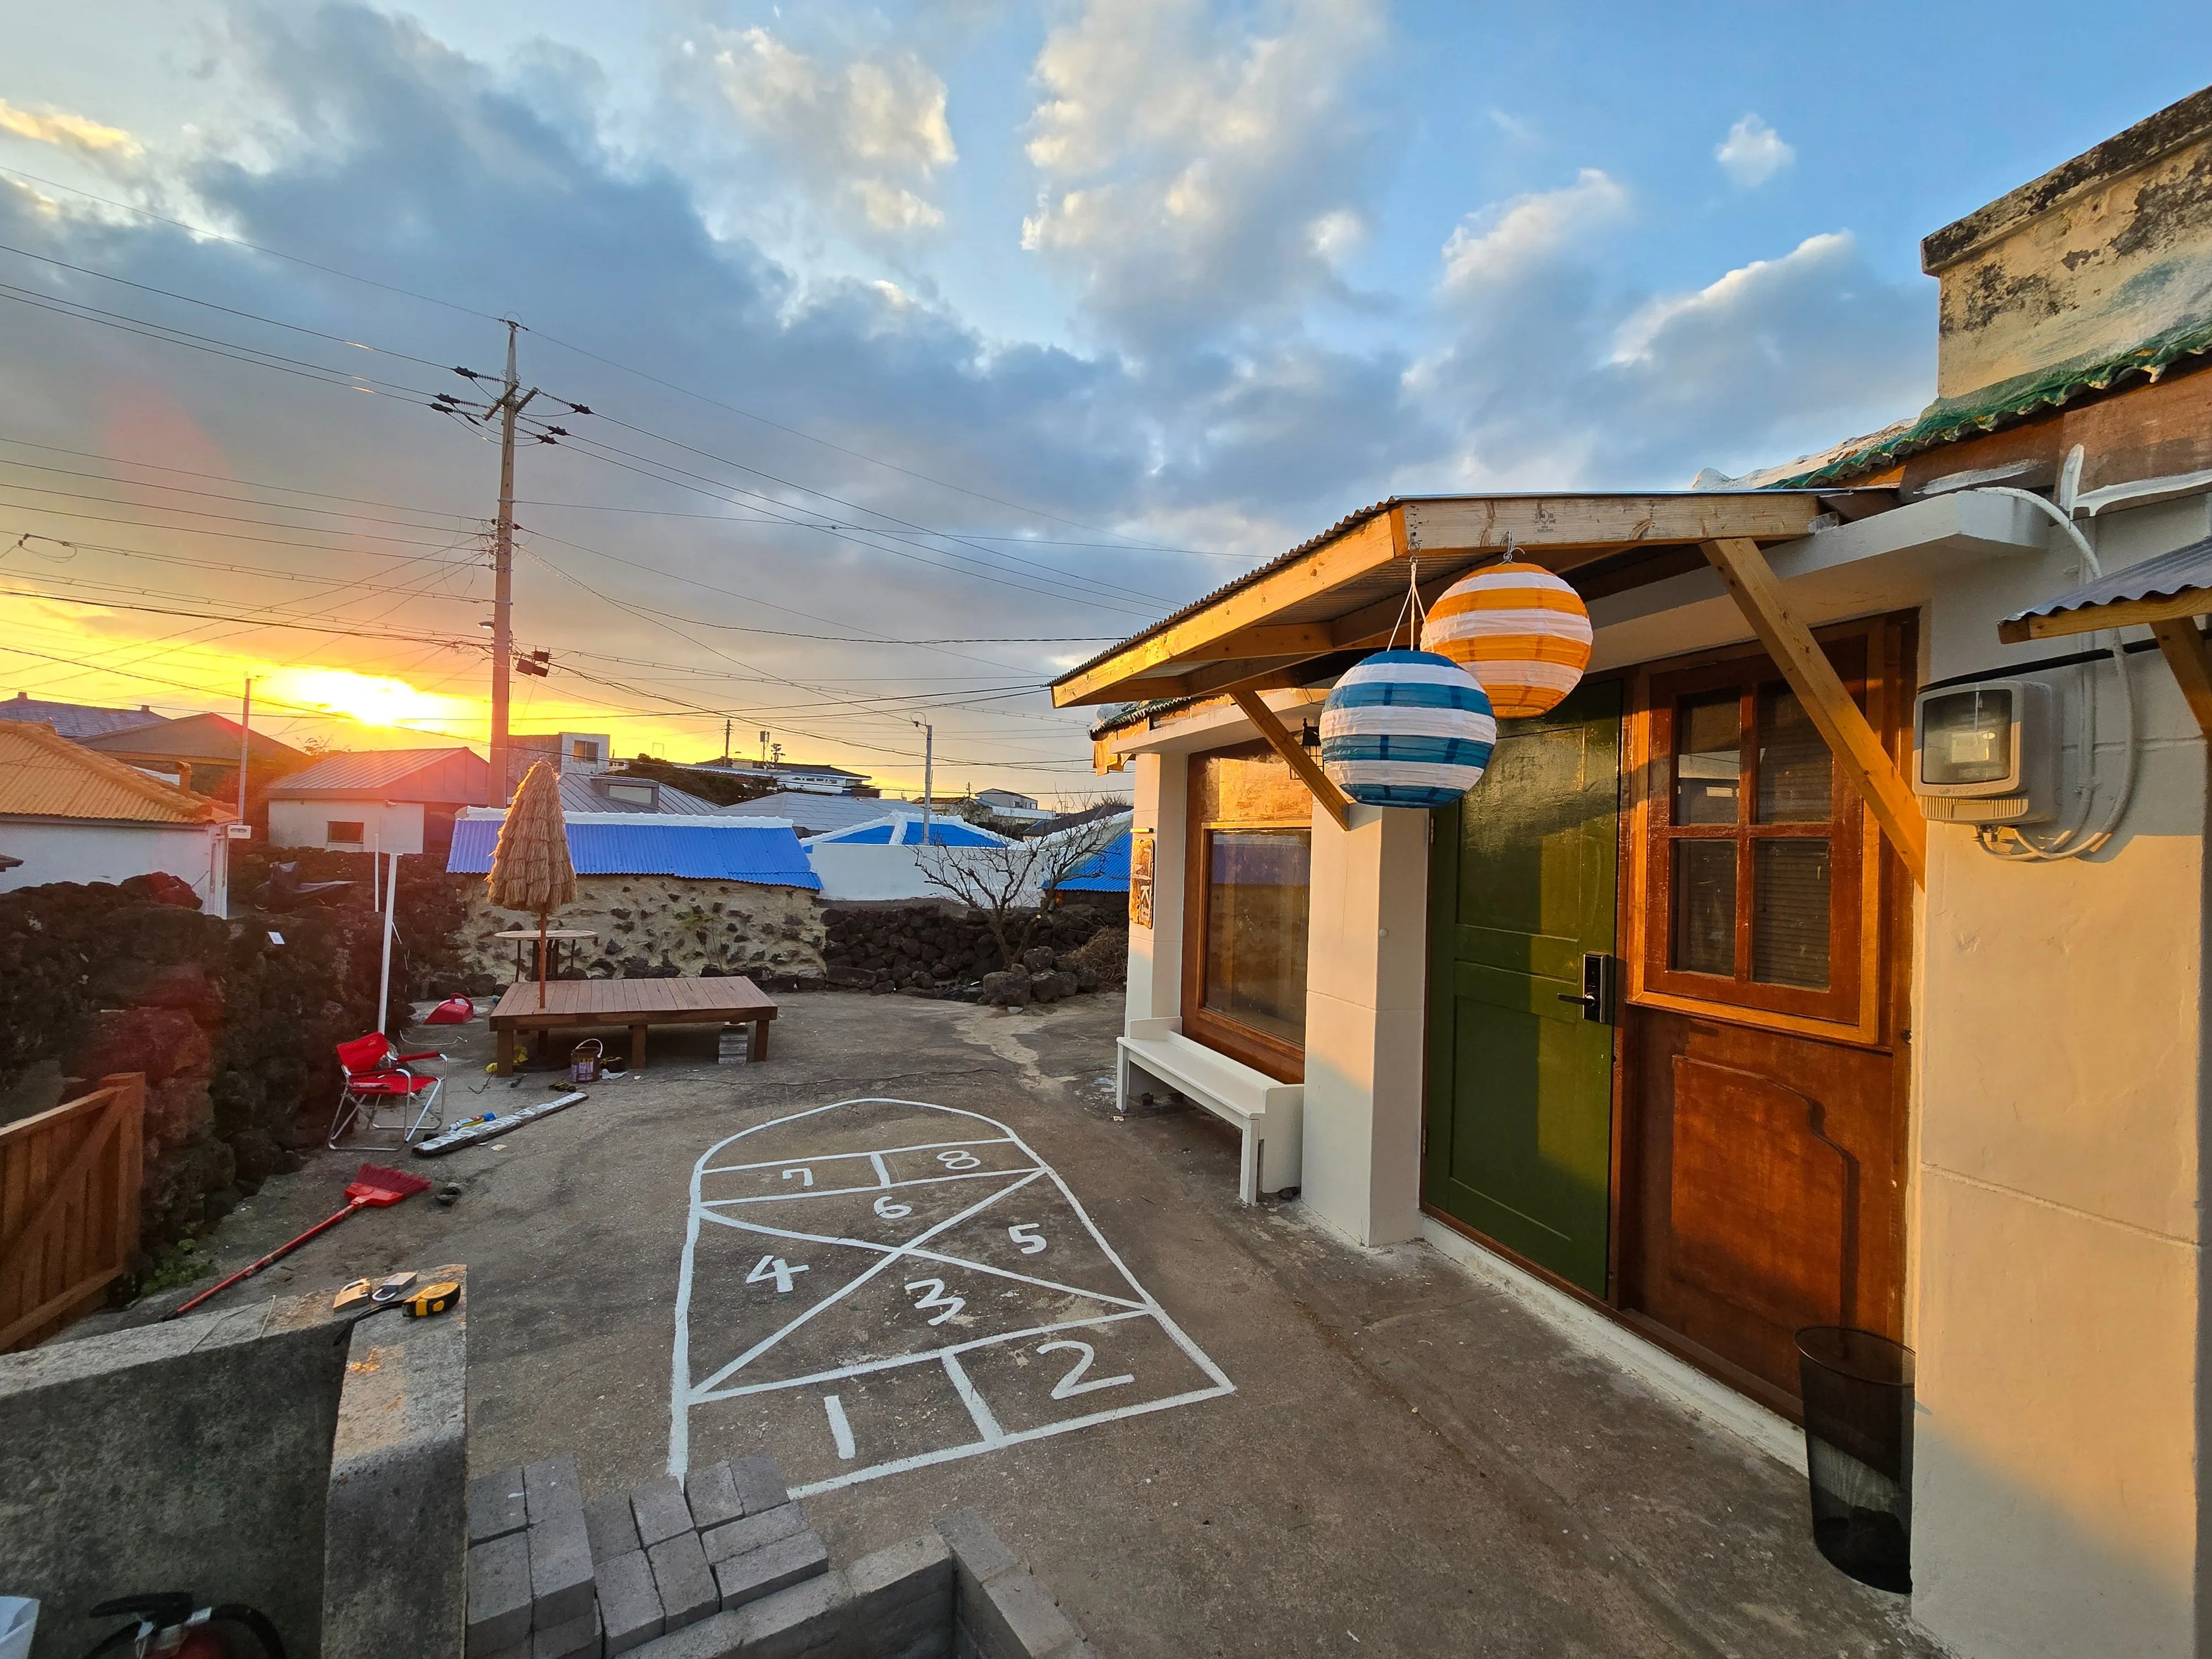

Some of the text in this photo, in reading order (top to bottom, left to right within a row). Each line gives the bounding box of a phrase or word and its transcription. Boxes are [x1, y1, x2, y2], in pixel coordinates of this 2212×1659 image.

[475, 1114, 522, 1131] NICE
[936, 1150, 981, 1170] 8
[781, 1167, 814, 1187] 7
[873, 1196, 914, 1219] 6
[1008, 1223, 1047, 1254] 5
[744, 1255, 810, 1293] 4
[904, 1277, 967, 1326] 3
[1036, 1340, 1135, 1400] 2
[823, 1394, 856, 1460] 1
